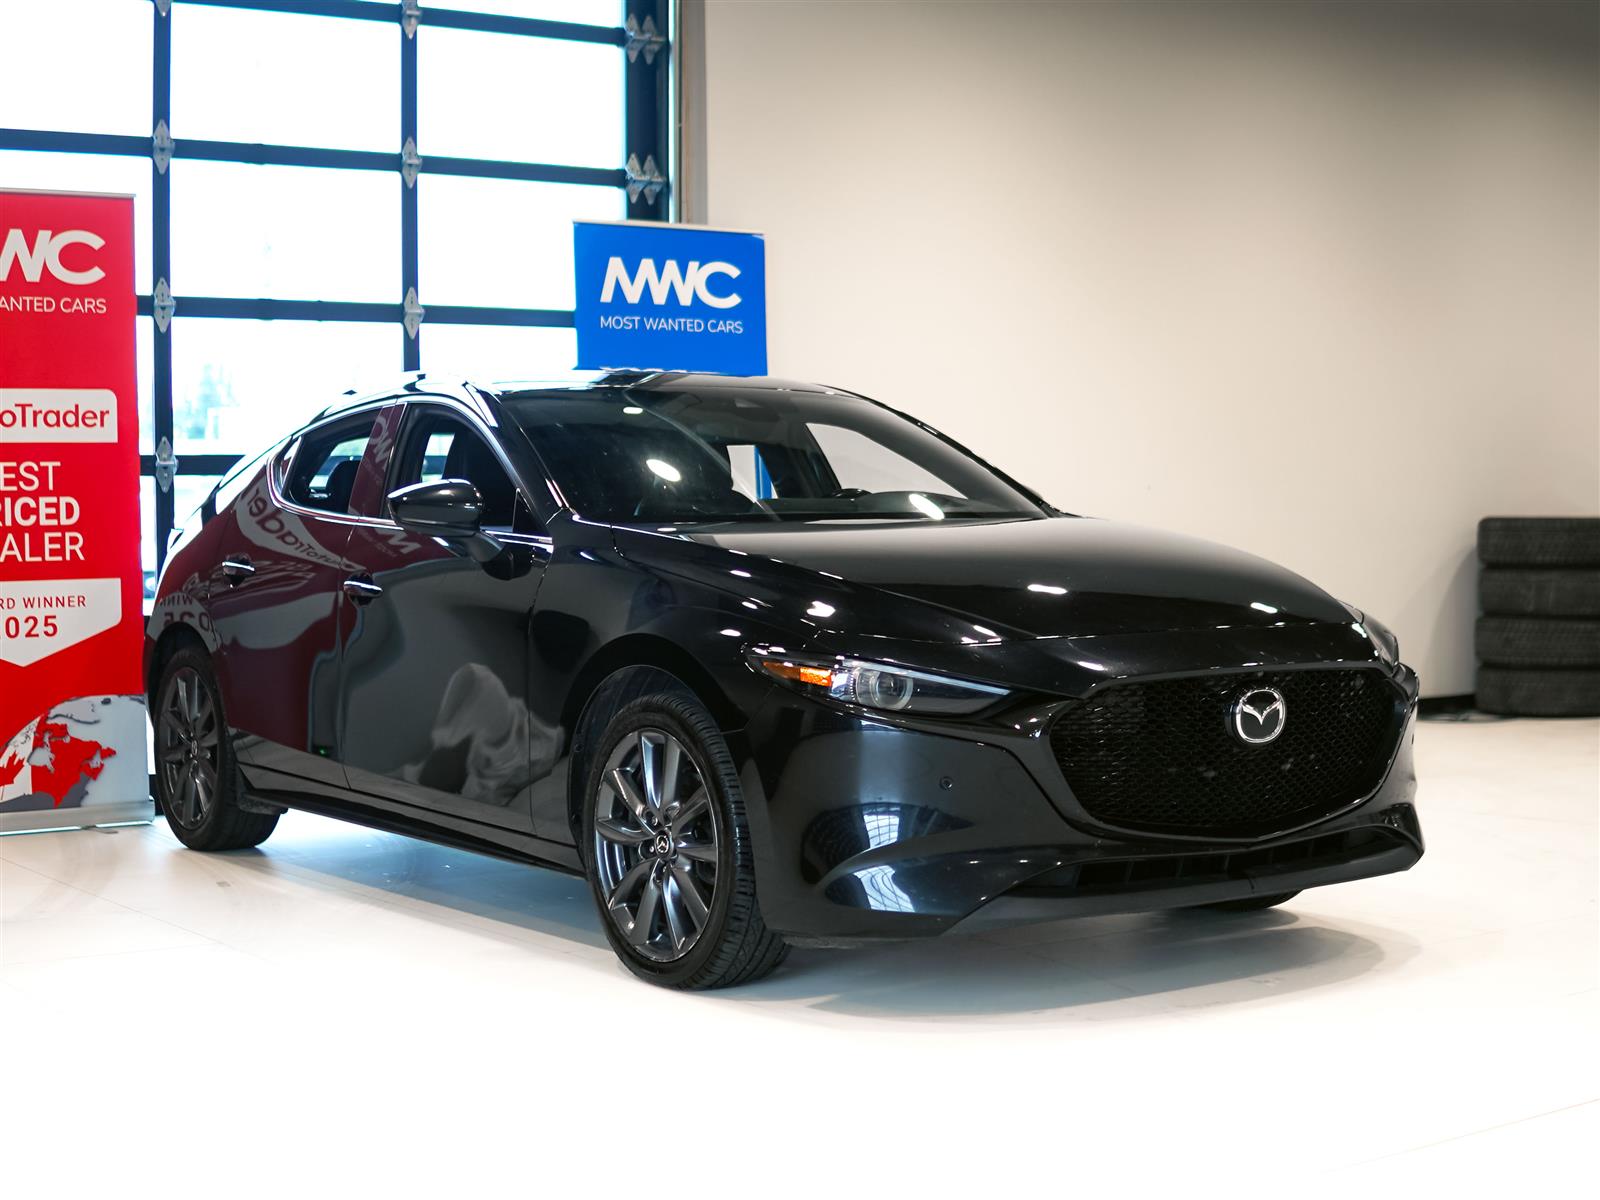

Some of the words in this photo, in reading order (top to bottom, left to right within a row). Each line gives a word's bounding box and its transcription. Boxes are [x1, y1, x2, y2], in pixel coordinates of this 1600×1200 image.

[600, 256, 742, 309] MWC
[60, 297, 107, 314] CARS
[600, 315, 641, 330] MOST
[643, 317, 704, 333] WANTED
[707, 319, 744, 334] CARS
[0, 403, 110, 428] oTrader
[0, 461, 61, 491] EST
[0, 496, 80, 527] ICED
[0, 531, 85, 562] ALER
[22, 595, 86, 609] WINNER
[5, 615, 58, 639] 025
